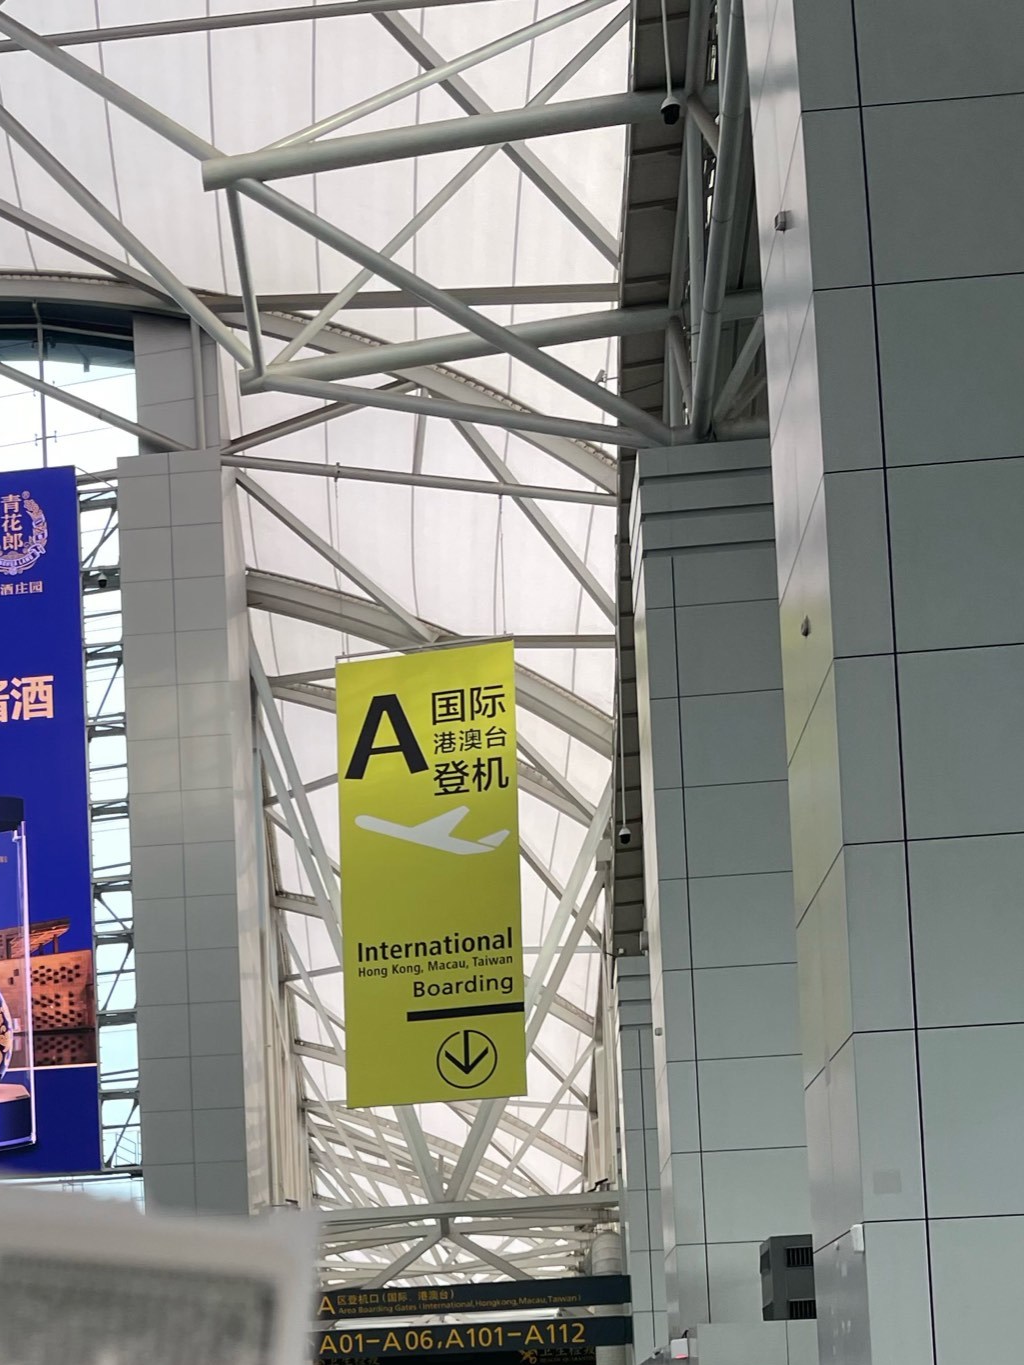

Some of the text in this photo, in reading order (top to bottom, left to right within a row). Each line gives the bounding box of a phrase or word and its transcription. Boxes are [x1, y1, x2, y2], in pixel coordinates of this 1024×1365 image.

[1, 494, 24, 550] 青花郎
[430, 684, 506, 726] 国际
[345, 693, 429, 780] A
[433, 725, 508, 756] 港澳台
[433, 756, 509, 796] 登机
[357, 927, 513, 963] International
[358, 954, 513, 979] Hong Kong, Macau, Taiwan
[413, 973, 514, 997] Boarding
[317, 1296, 335, 1316] A
[358, 1306, 393, 1314] Boarding
